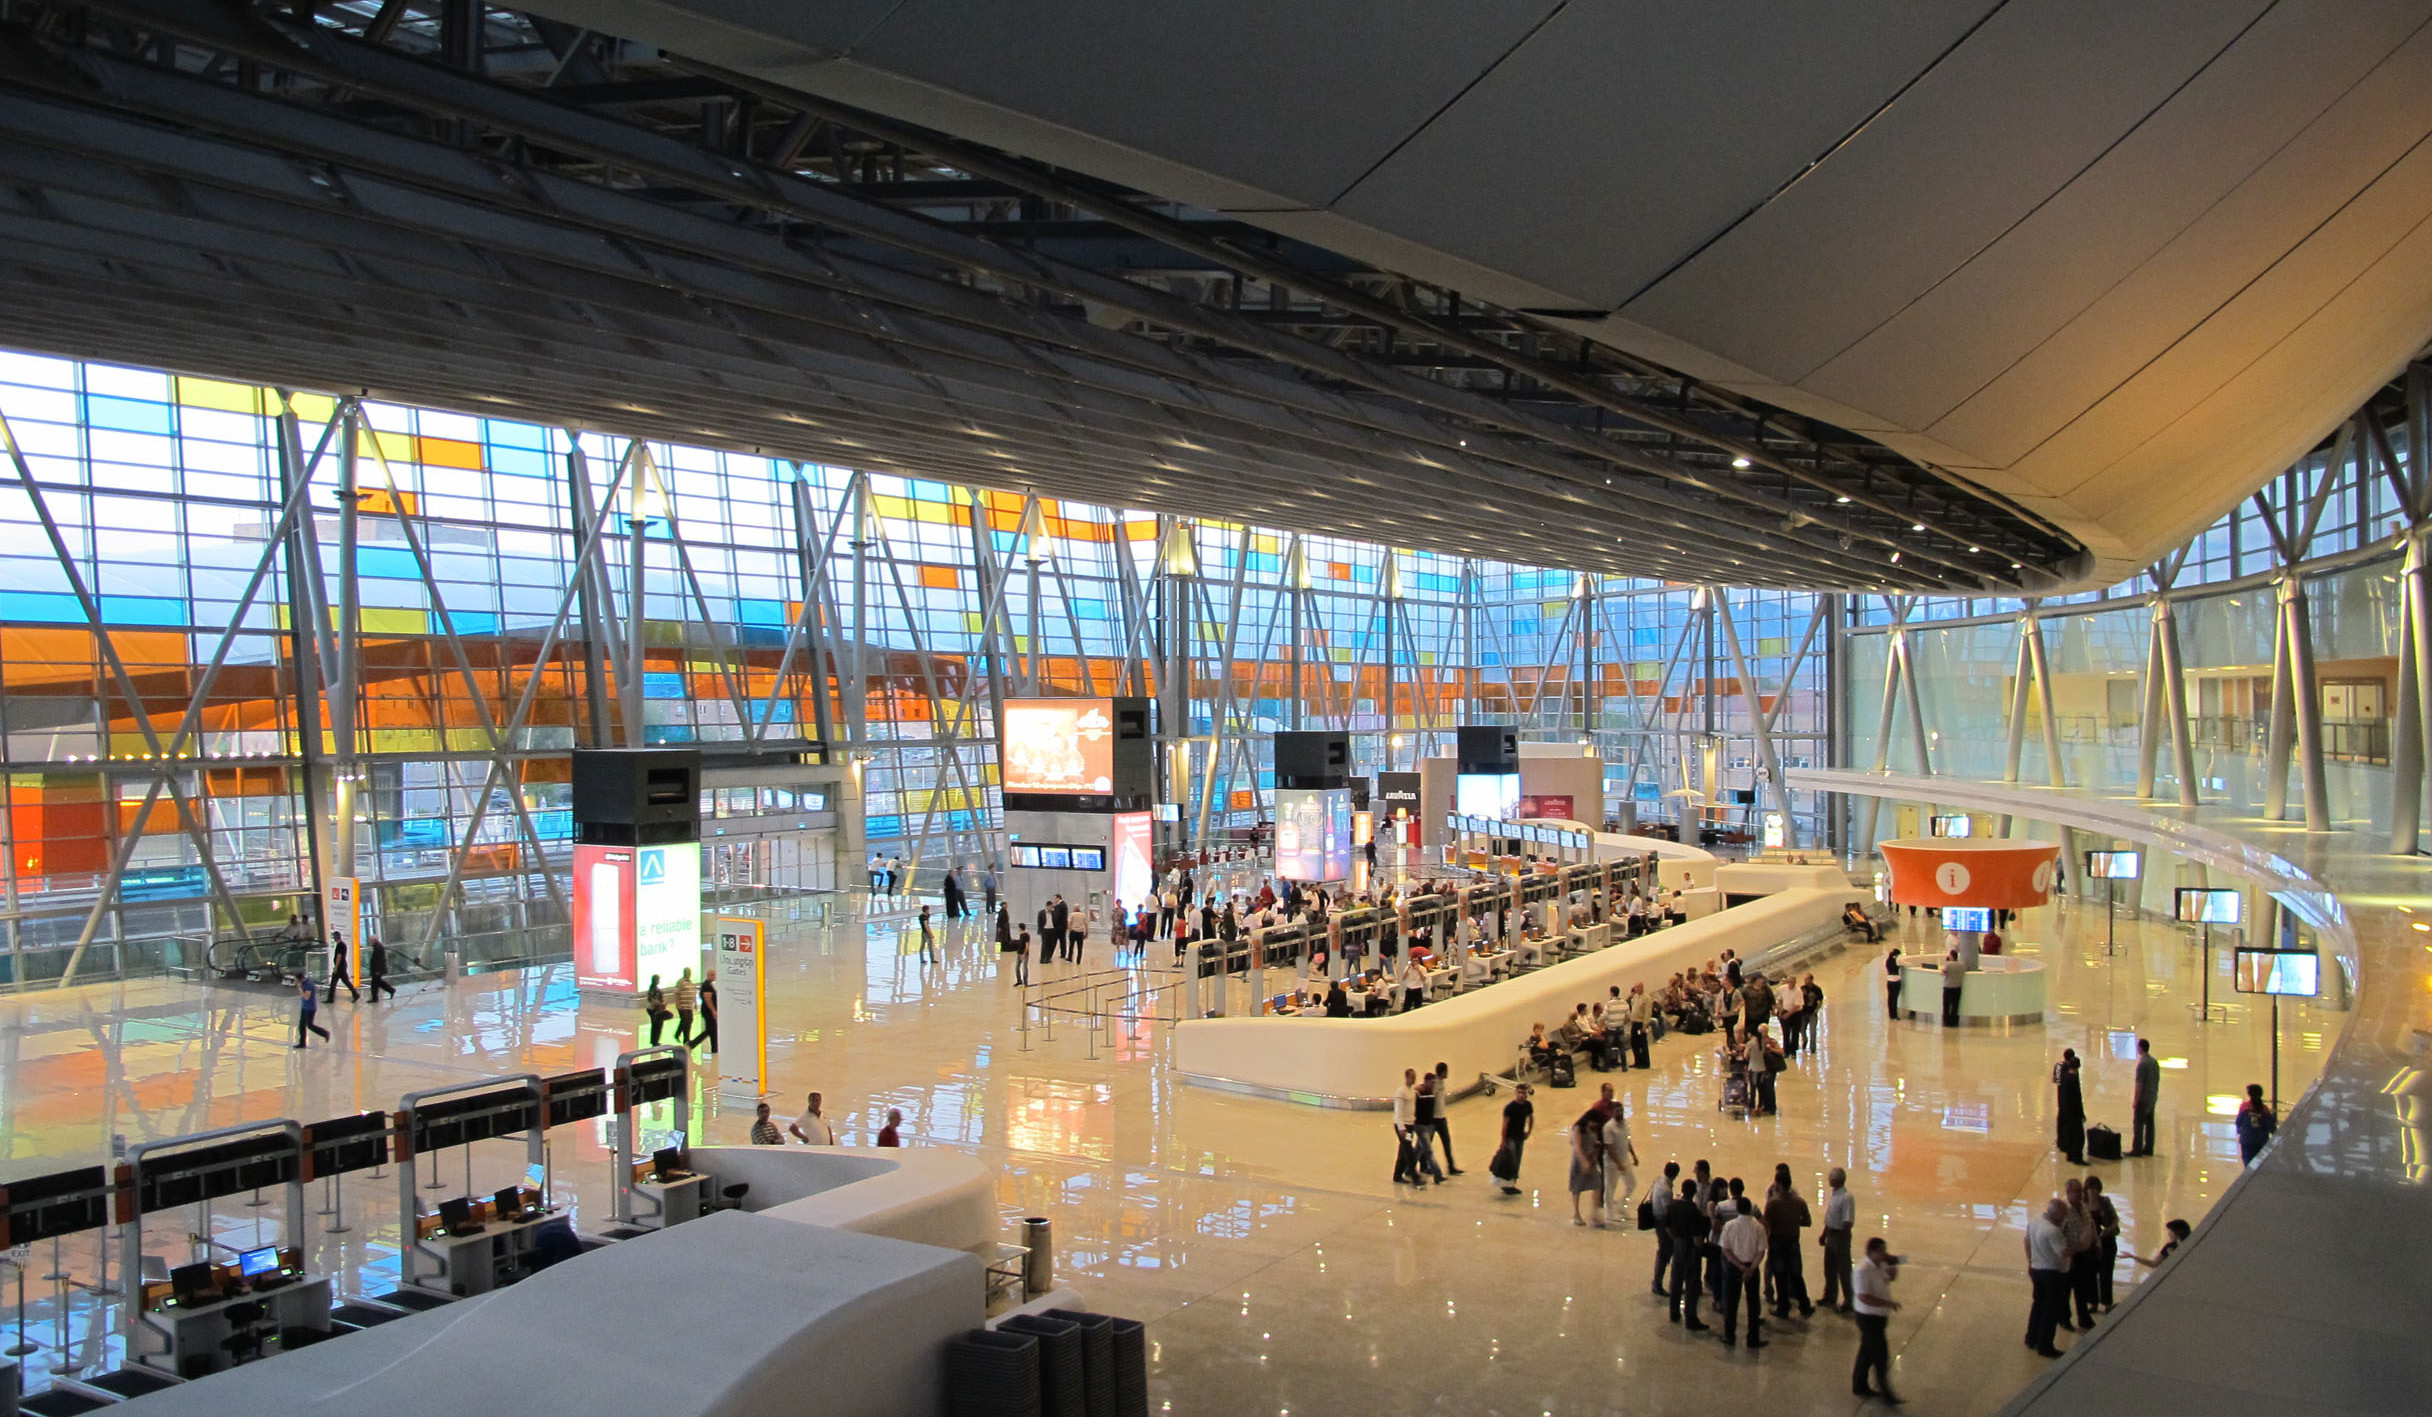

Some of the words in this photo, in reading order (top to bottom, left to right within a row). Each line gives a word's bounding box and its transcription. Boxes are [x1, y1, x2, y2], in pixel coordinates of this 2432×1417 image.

[640, 926, 646, 936] a
[651, 919, 692, 934] reliable
[641, 939, 674, 956] bank?
[723, 938, 735, 949] 1-8
[727, 966, 746, 976] Gates
[11, 1249, 30, 1257] EXIT
